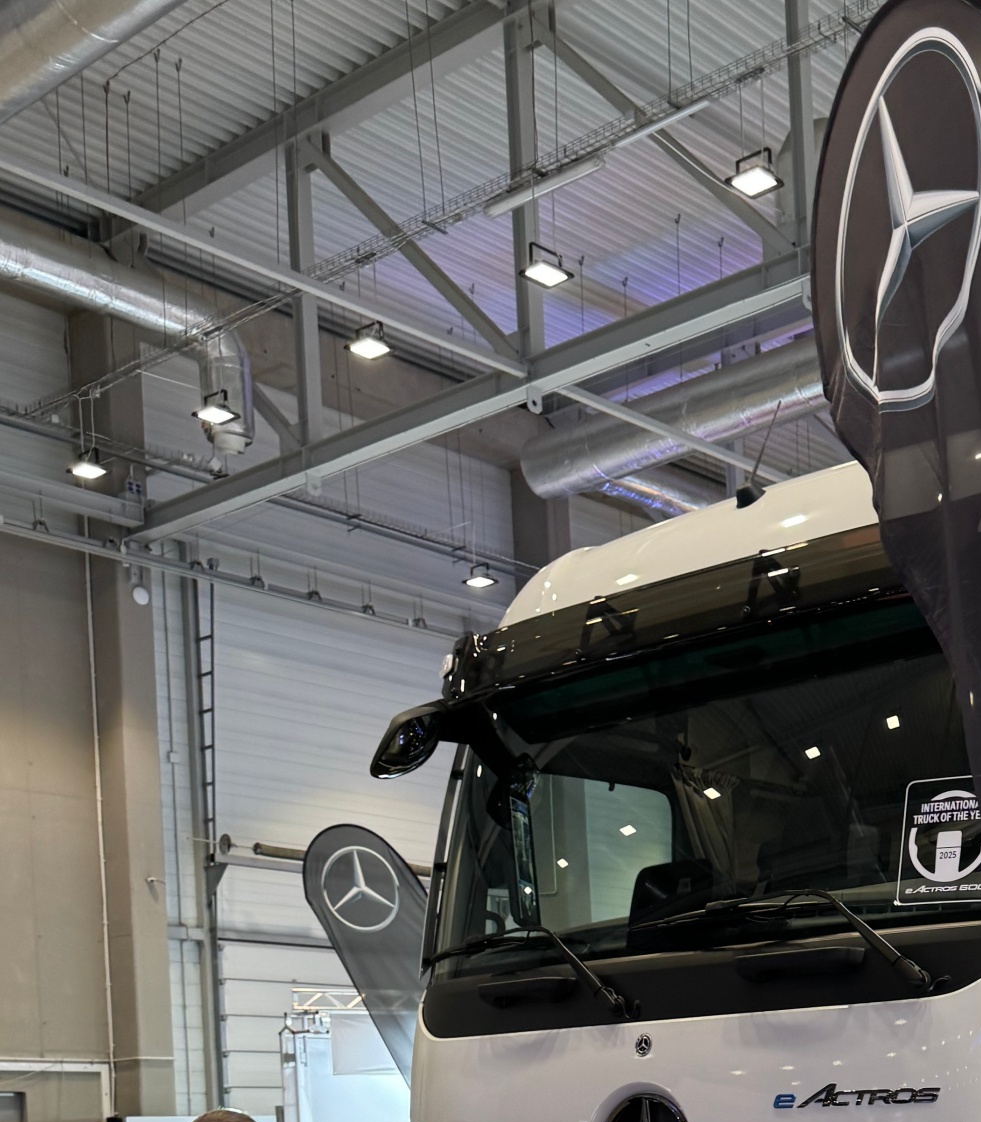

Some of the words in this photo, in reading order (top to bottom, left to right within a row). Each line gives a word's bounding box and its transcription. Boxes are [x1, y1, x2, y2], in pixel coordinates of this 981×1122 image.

[921, 799, 979, 813] INTERNATIONA
[913, 812, 939, 825] TRUCK
[940, 812, 952, 823] OF
[952, 811, 969, 822] THE
[939, 851, 957, 859] 2025
